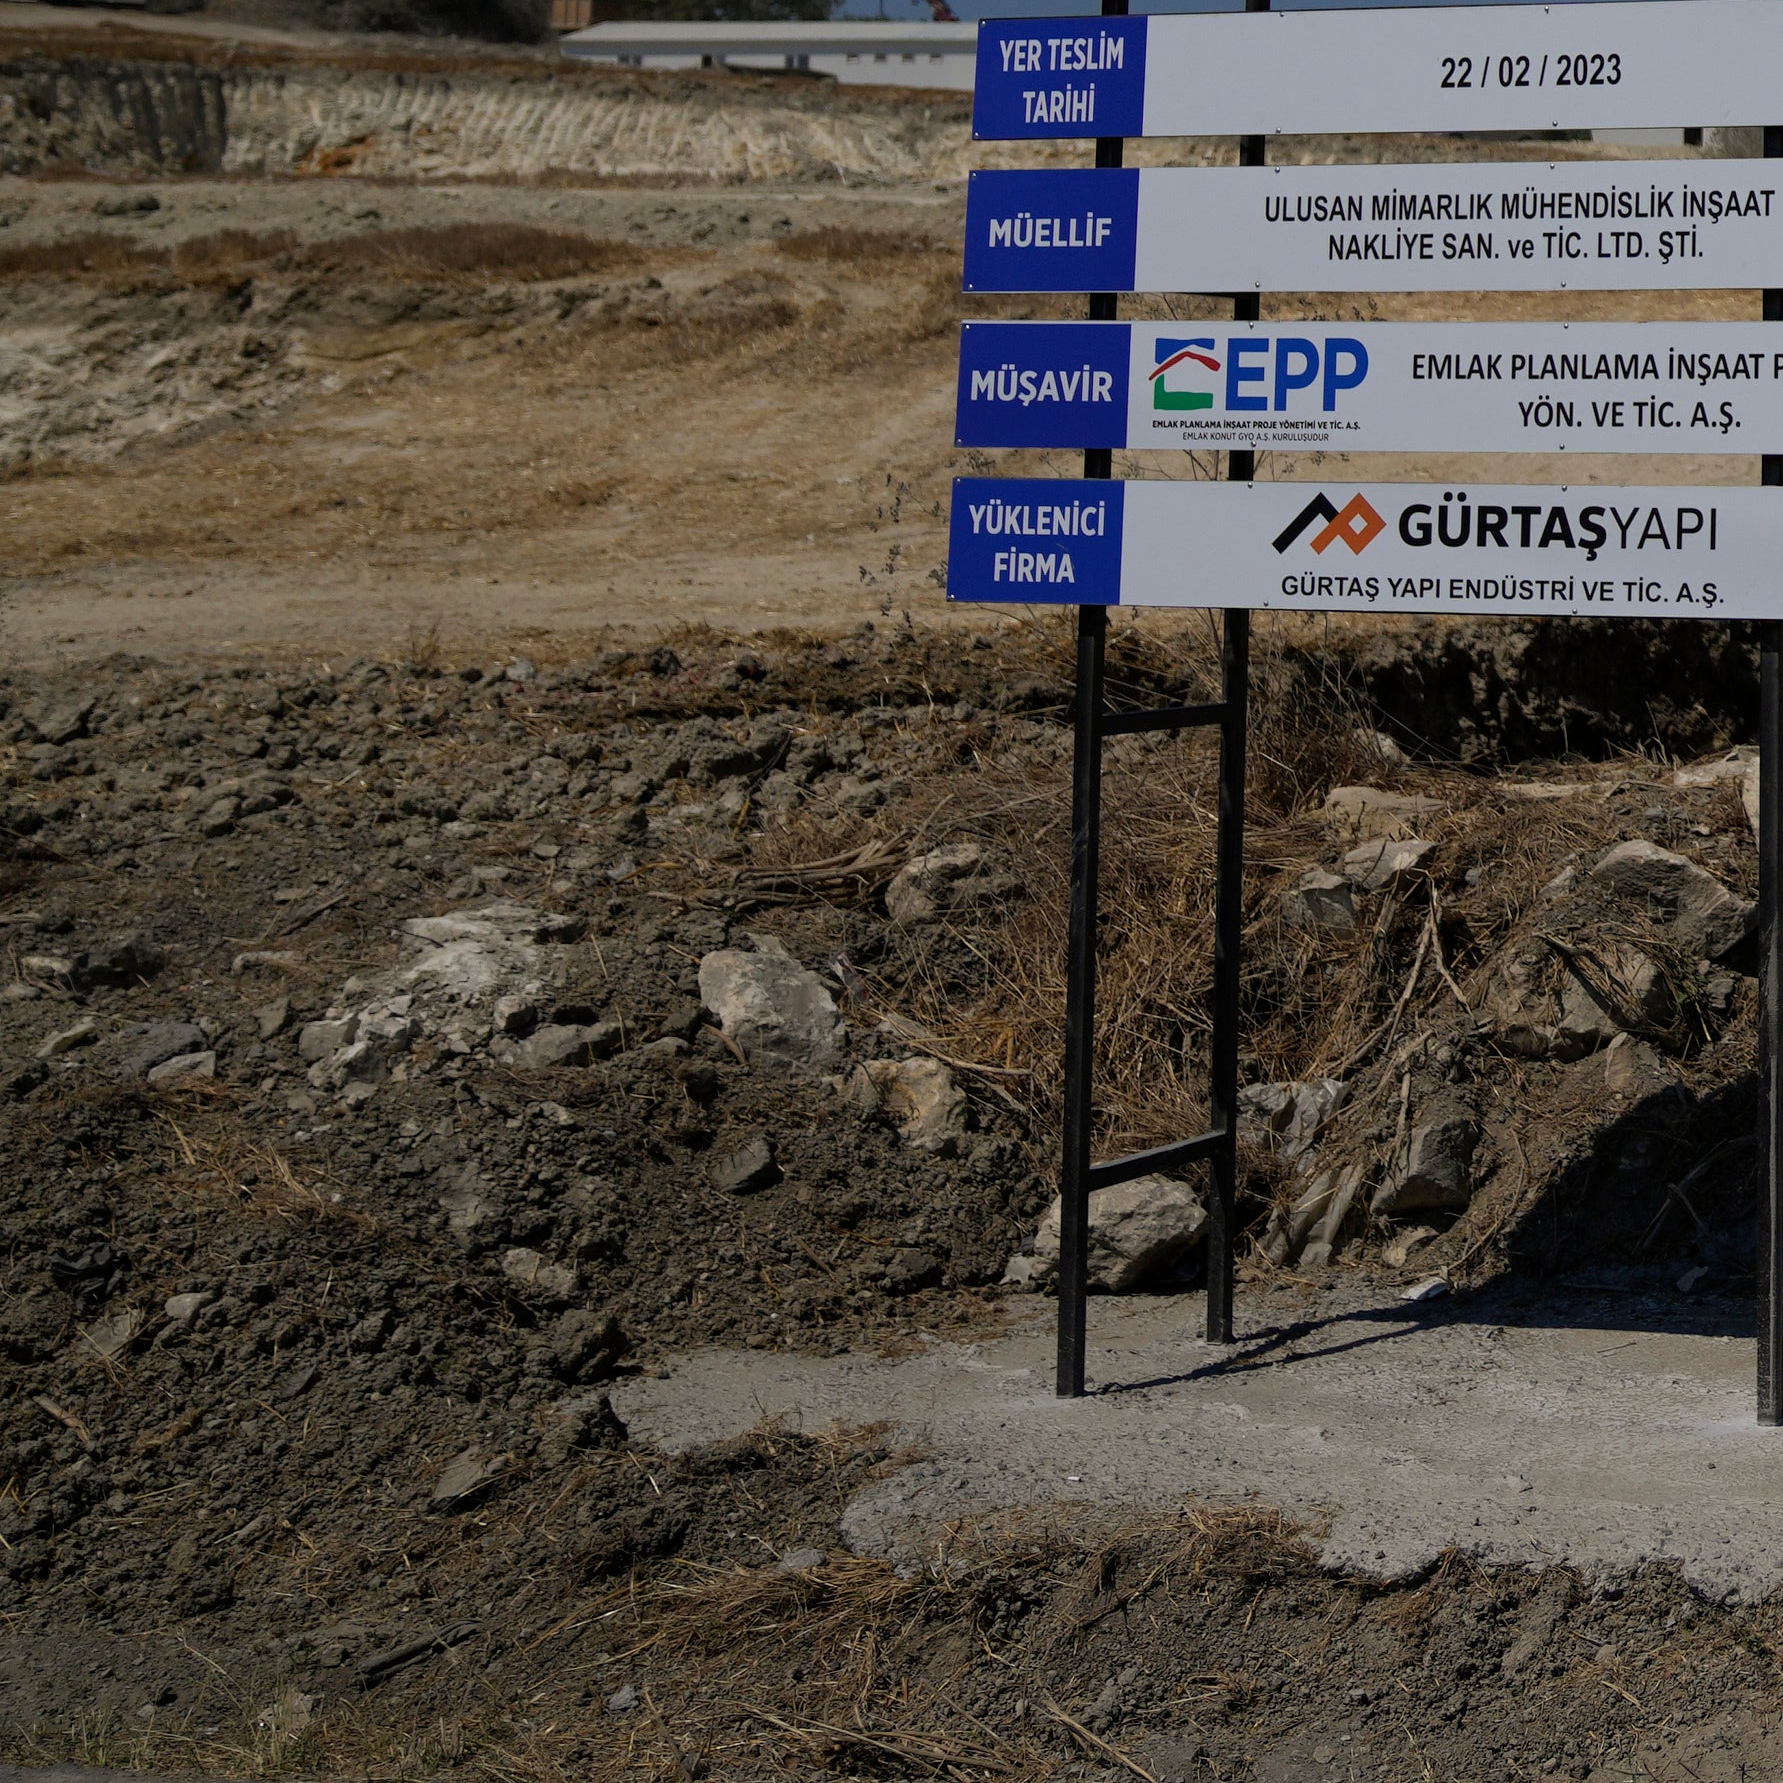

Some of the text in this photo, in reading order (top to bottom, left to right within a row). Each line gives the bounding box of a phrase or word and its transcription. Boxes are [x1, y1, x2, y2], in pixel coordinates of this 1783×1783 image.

[1000, 31, 1124, 71] YER TESLİM
[1441, 54, 1621, 88] 22 / 02 / 2023
[1023, 83, 1094, 123] TARİHİ
[1266, 185, 1775, 229] ULUSAN MİMARLIK MÜHENDİSLİK İNŞAAT
[989, 212, 1111, 247] MÜELLİF
[1329, 224, 1702, 264] NAKLİYE SAN. ve TİC. LTD. ŞTİ.
[971, 364, 1112, 406] MÜŞAVİR
[1413, 355, 1502, 379] EMLAK
[1512, 354, 1659, 379] PLANLAMA
[1669, 347, 1764, 386] İNŞAAT
[1153, 419, 1360, 431] EMLAK PLANLAMA İNŞAAT PROJE YÖNETİMİ VE TİC. A.Ş.
[1519, 395, 1740, 434] YÖN. VE TİC. A.Ş.
[1183, 432, 1328, 442] EMLAK KONUT GYO A.Ş. KURULUŞUDUR
[969, 499, 1104, 536] YÜKLENİCİ
[994, 547, 1074, 583] FİRMA
[1282, 572, 1723, 608] GÜRTAŞ YAPI ENDÜSTRİ VE TİC. A.Ş.
